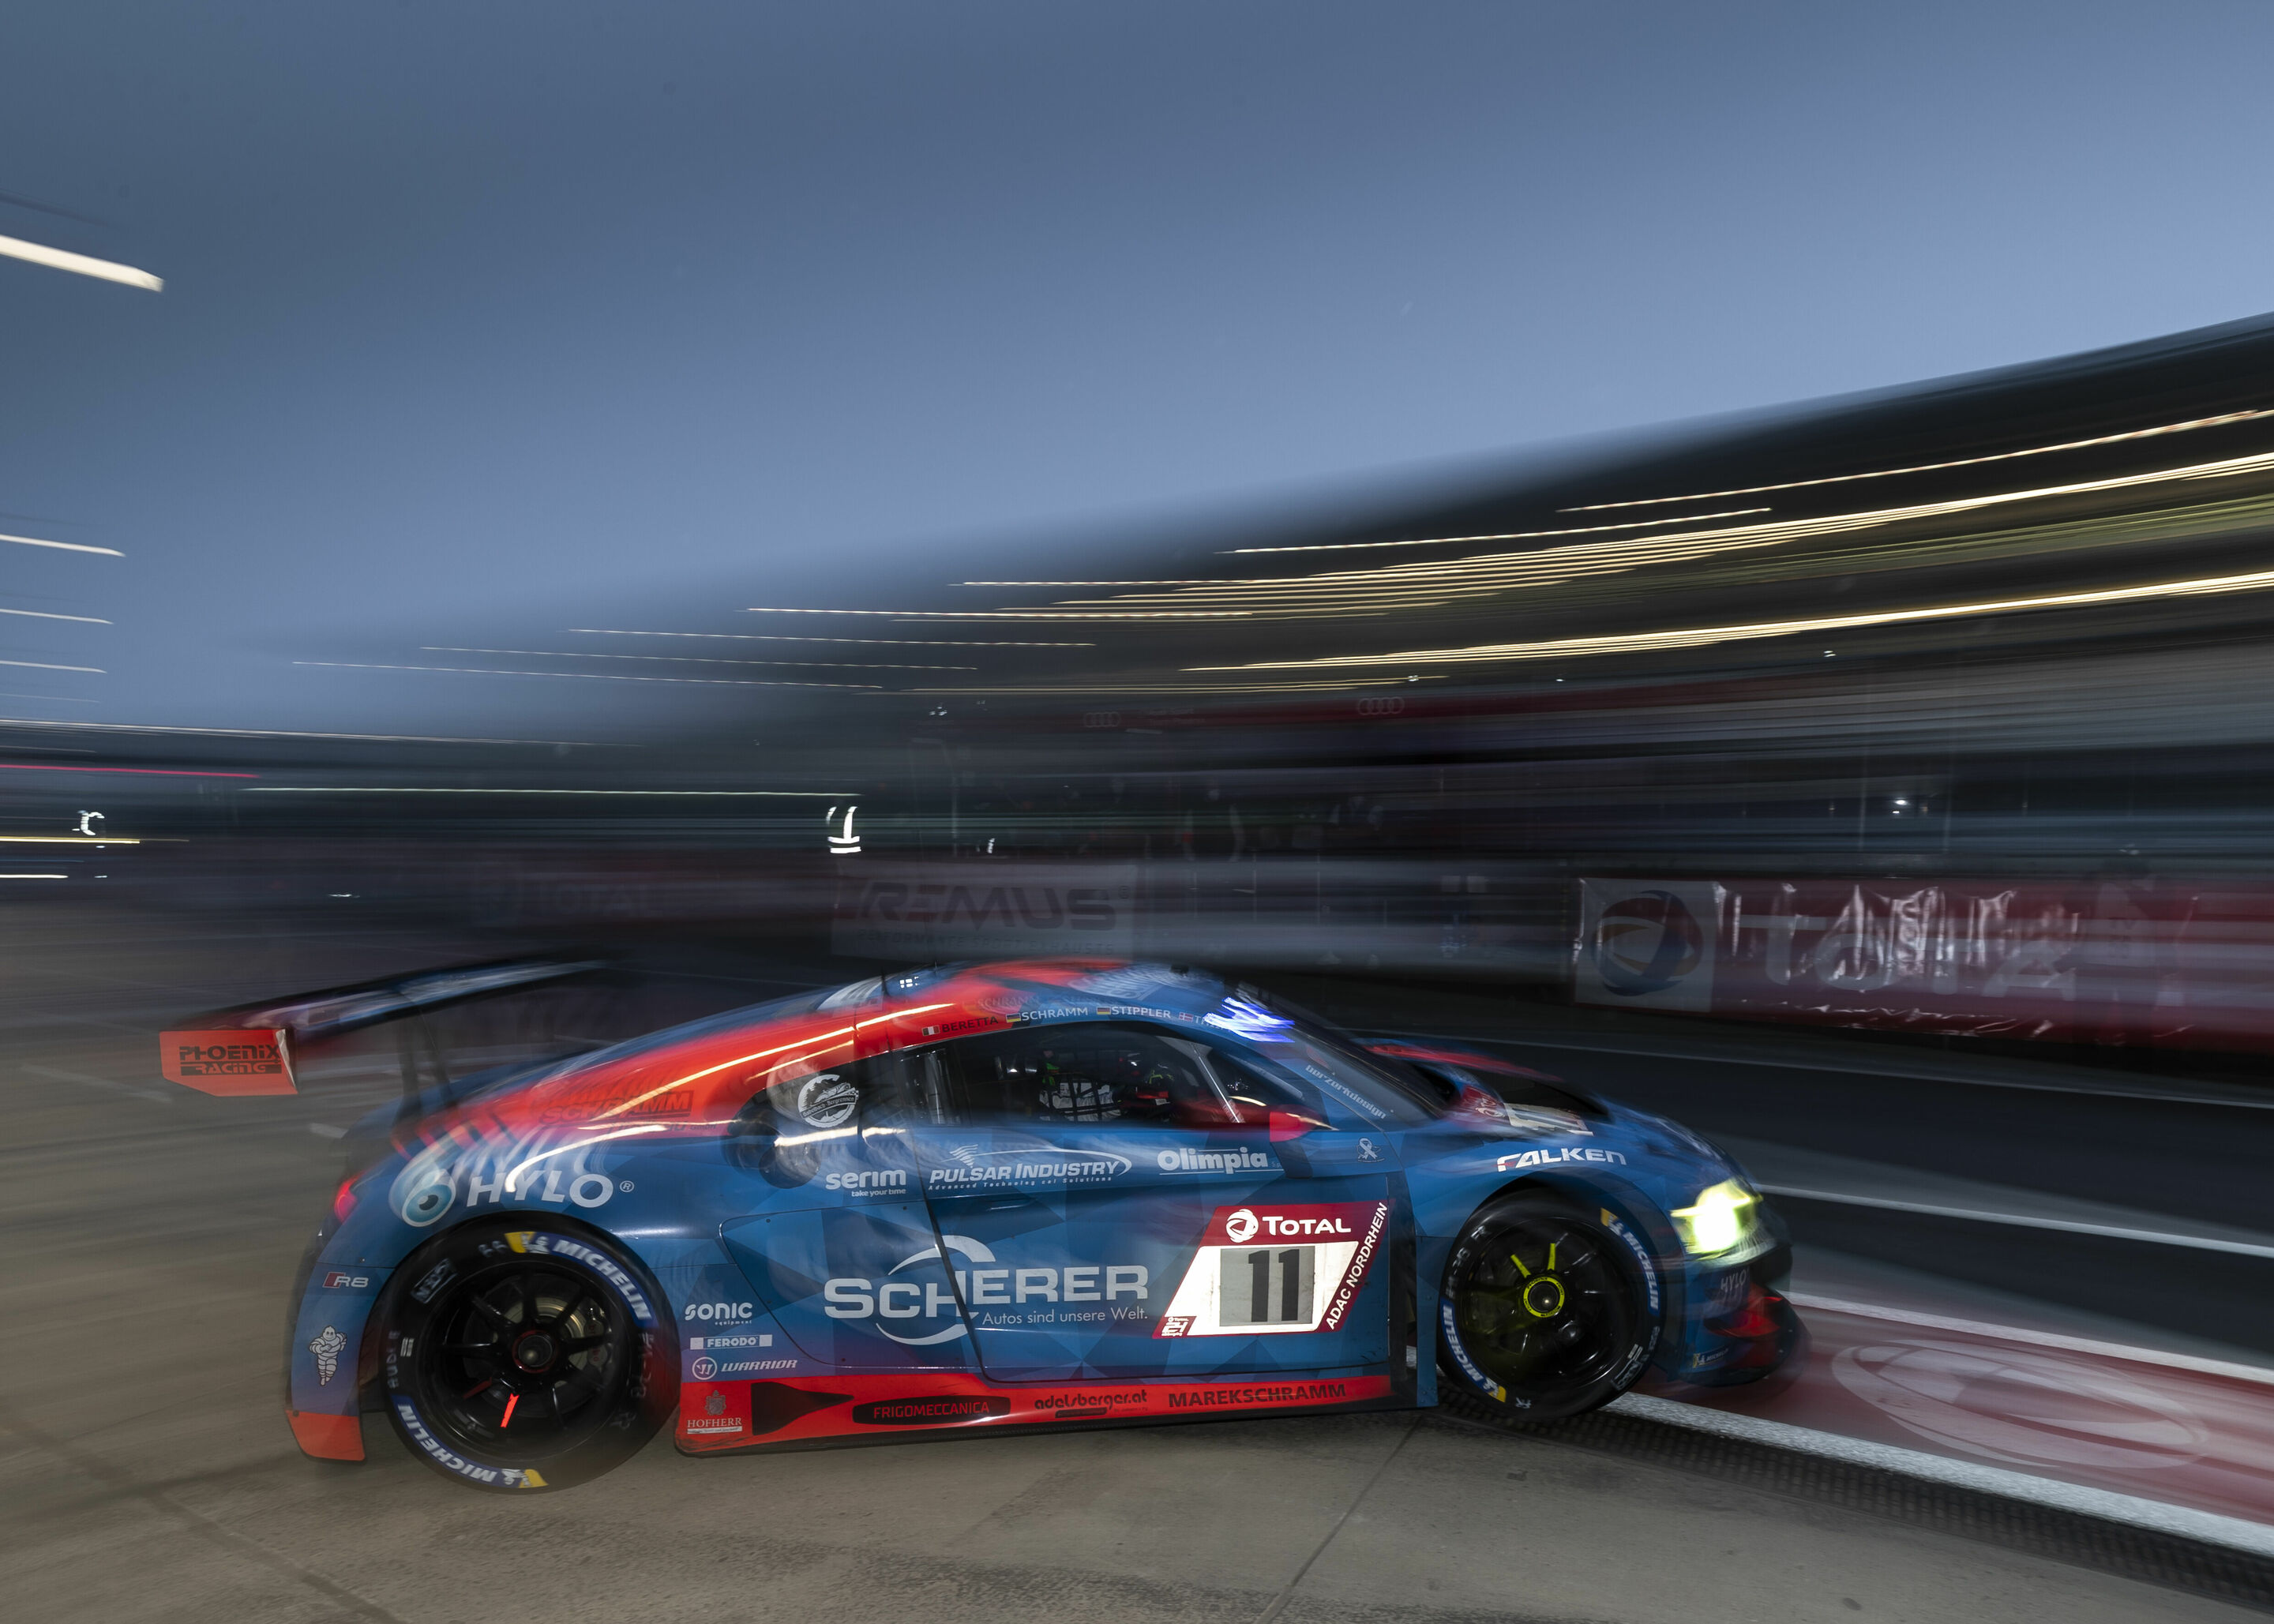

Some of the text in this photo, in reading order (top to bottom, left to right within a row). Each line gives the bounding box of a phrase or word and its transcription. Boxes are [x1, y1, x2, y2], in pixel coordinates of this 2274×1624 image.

[1021, 1007, 1089, 1021] SCHRAMM
[1110, 1006, 1171, 1018] STIPPLER
[941, 1015, 999, 1033] BERETTA
[1158, 1147, 1268, 1174] Olimpia
[1496, 1148, 1627, 1172] FALKEN
[929, 1161, 1119, 1183] PULSAR INDUSTRY
[851, 1188, 869, 1198] take
[869, 1189, 887, 1198] your
[1263, 1216, 1351, 1236] TOTAL
[1326, 1288, 1351, 1330] ADAC
[1346, 1202, 1387, 1288] NORDRHEIN
[1622, 1231, 1659, 1311] MICHELIN
[333, 1276, 369, 1288] R8
[552, 1240, 652, 1321] MICHELIN
[1248, 1248, 1300, 1322] 11
[824, 1265, 1149, 1319] SCHERER
[982, 1306, 1148, 1325] Autos sind unsere Welt.
[707, 1337, 756, 1348] FERODO
[1443, 1304, 1485, 1382] MICHELIN
[721, 1360, 797, 1372] WARRIOR
[1034, 1389, 1147, 1410] adelsberger.at
[1169, 1384, 1346, 1408] MAREKSCHRAMM
[873, 1401, 989, 1419] FRIGOMECCANICA
[687, 1417, 742, 1428] HOFHERR
[397, 1404, 497, 1483] MICHELIN
